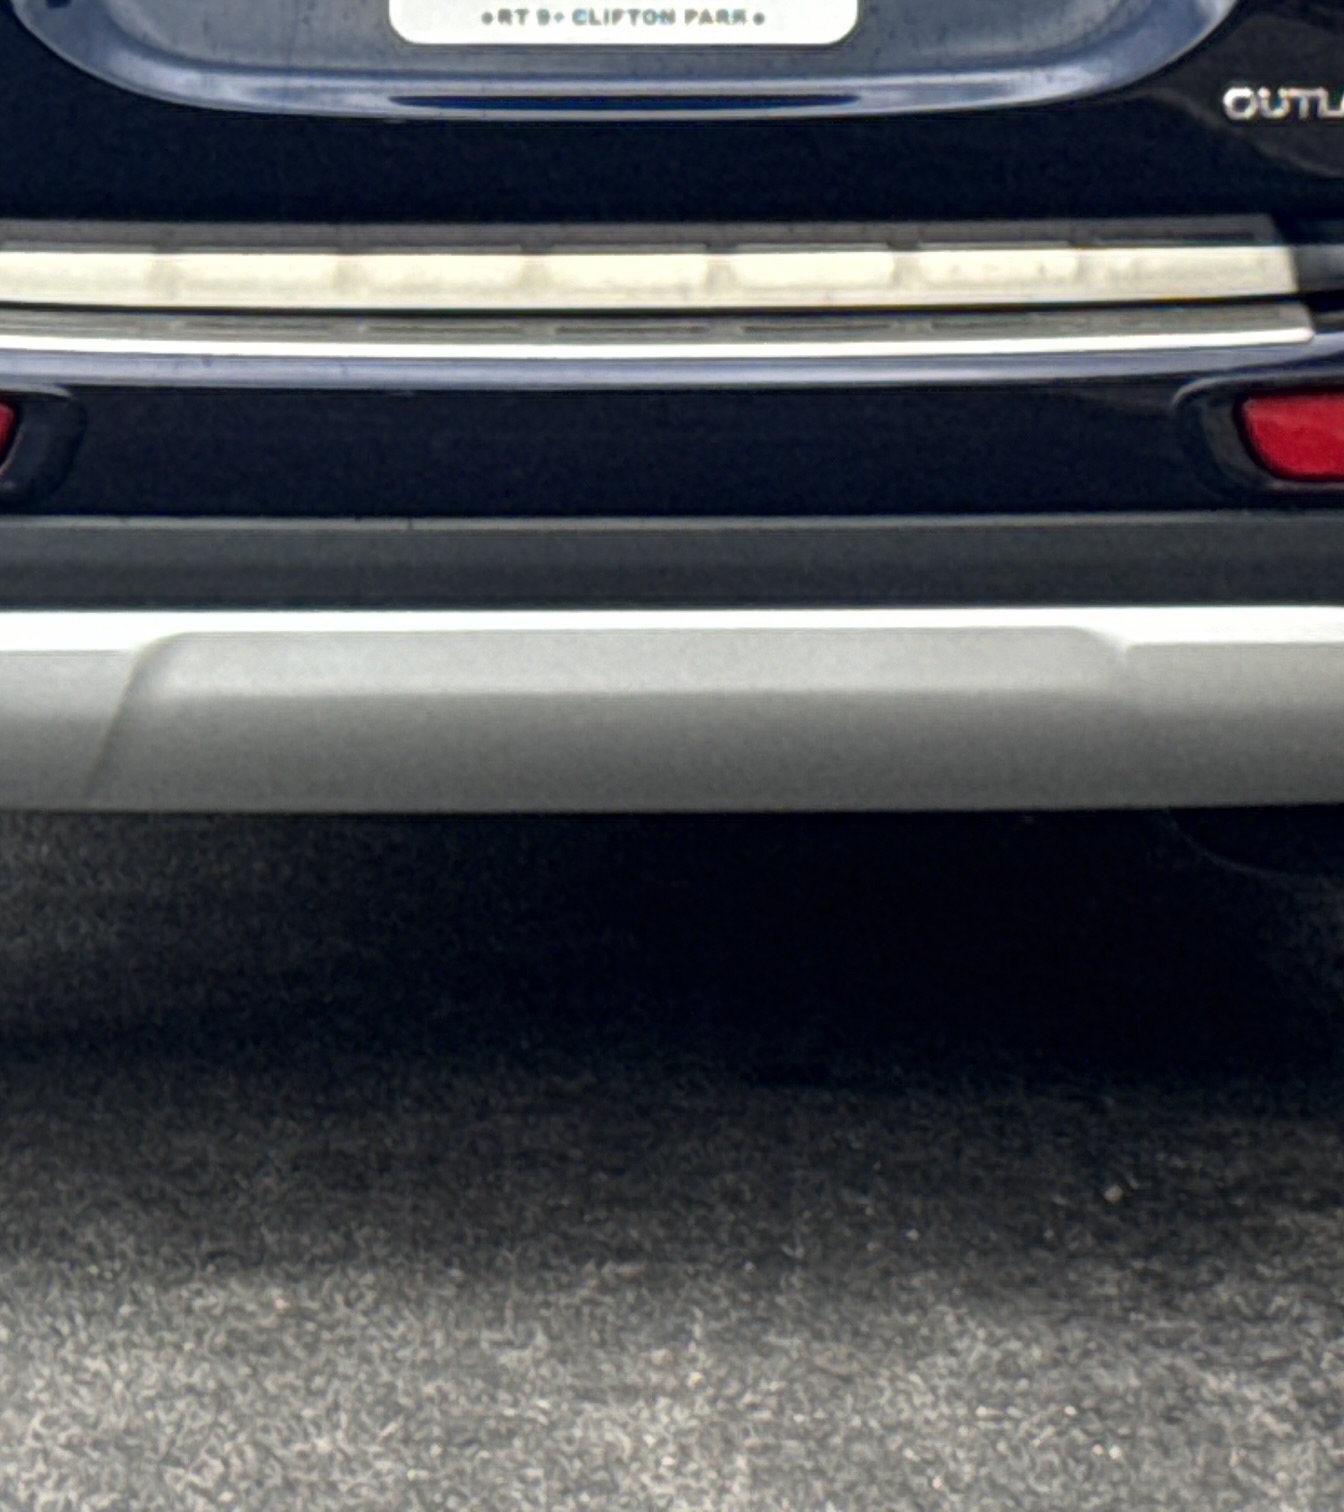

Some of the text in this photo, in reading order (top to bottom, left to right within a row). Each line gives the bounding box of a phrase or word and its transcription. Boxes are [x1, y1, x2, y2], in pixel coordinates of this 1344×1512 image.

[497, 8, 530, 26] RT
[571, 8, 676, 26] CLIFTON
[684, 8, 749, 26] PARK
